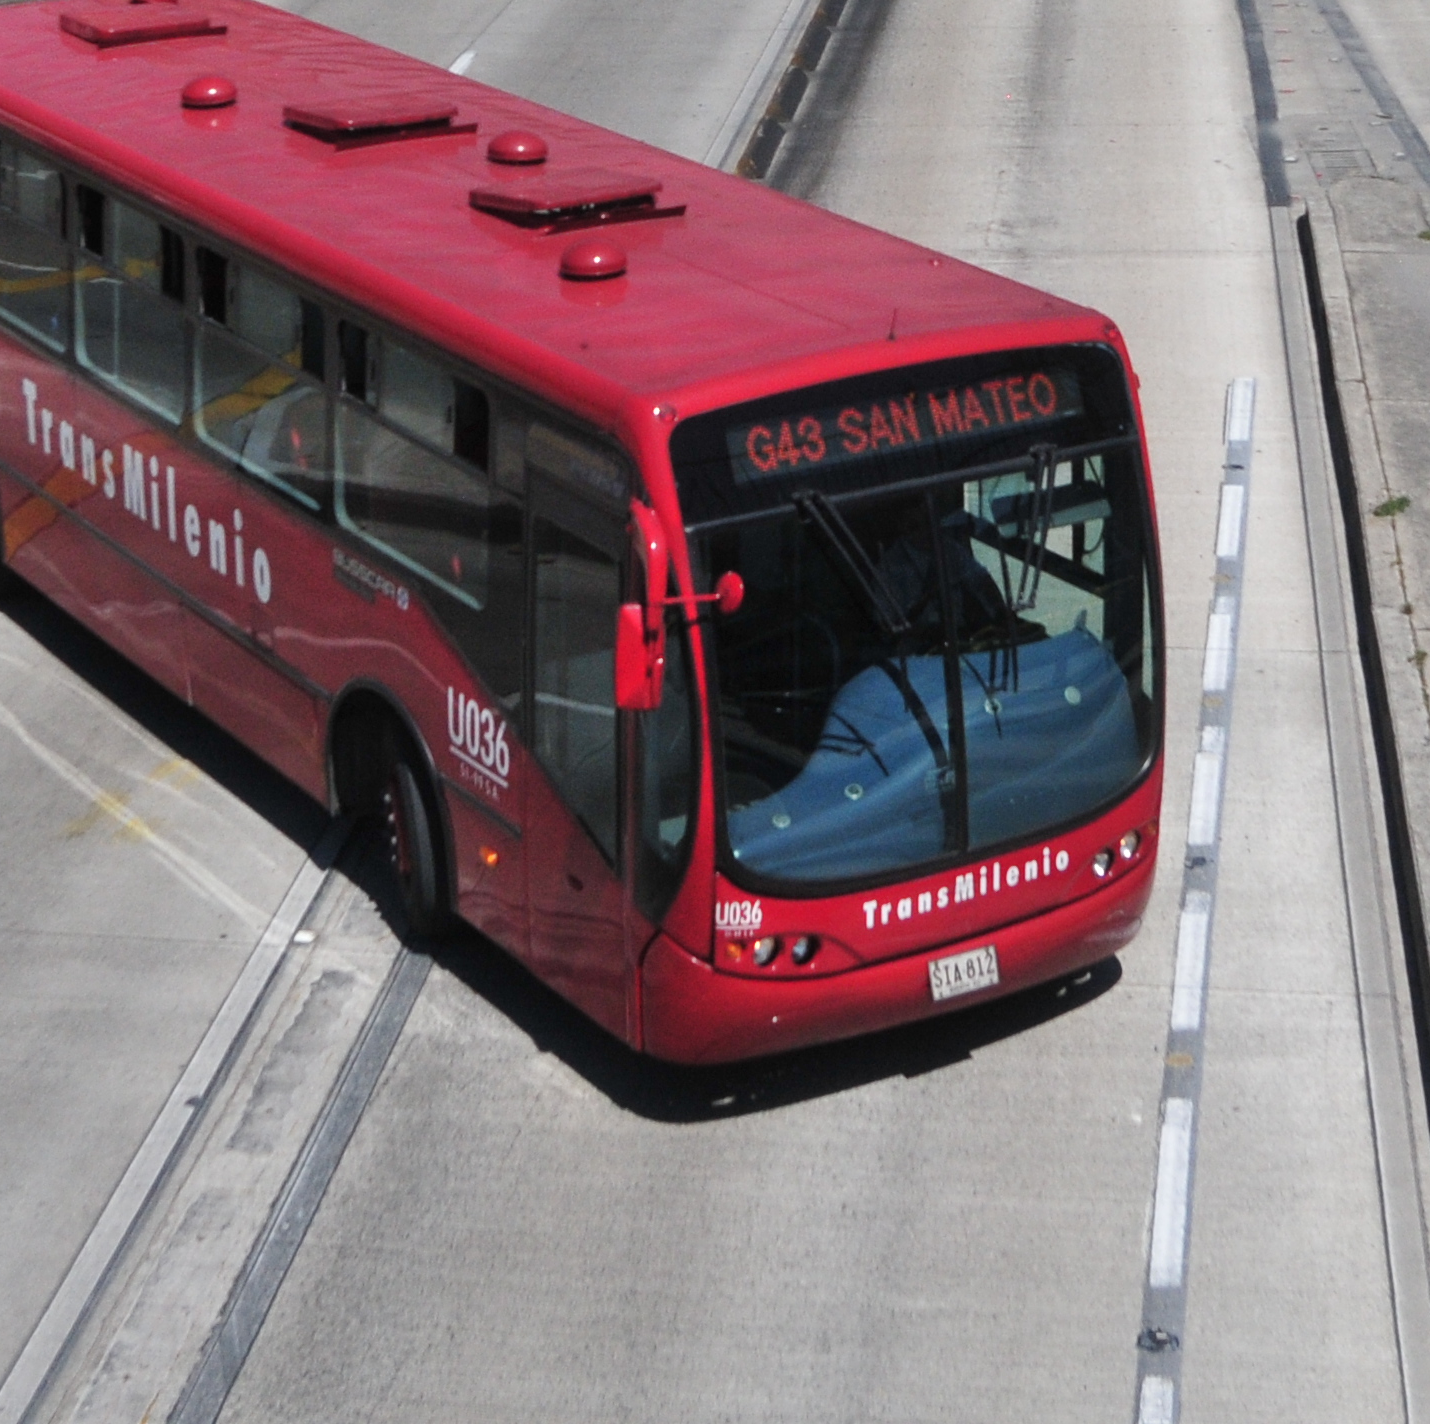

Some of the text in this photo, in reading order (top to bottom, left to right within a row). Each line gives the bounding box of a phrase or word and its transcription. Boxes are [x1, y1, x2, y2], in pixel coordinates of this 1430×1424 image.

[745, 372, 1058, 472] G43 SAN MATEO
[22, 377, 271, 604] TransMilenio
[447, 686, 510, 777] U036
[715, 898, 763, 926] U036
[862, 846, 1069, 930] TransMilenio
